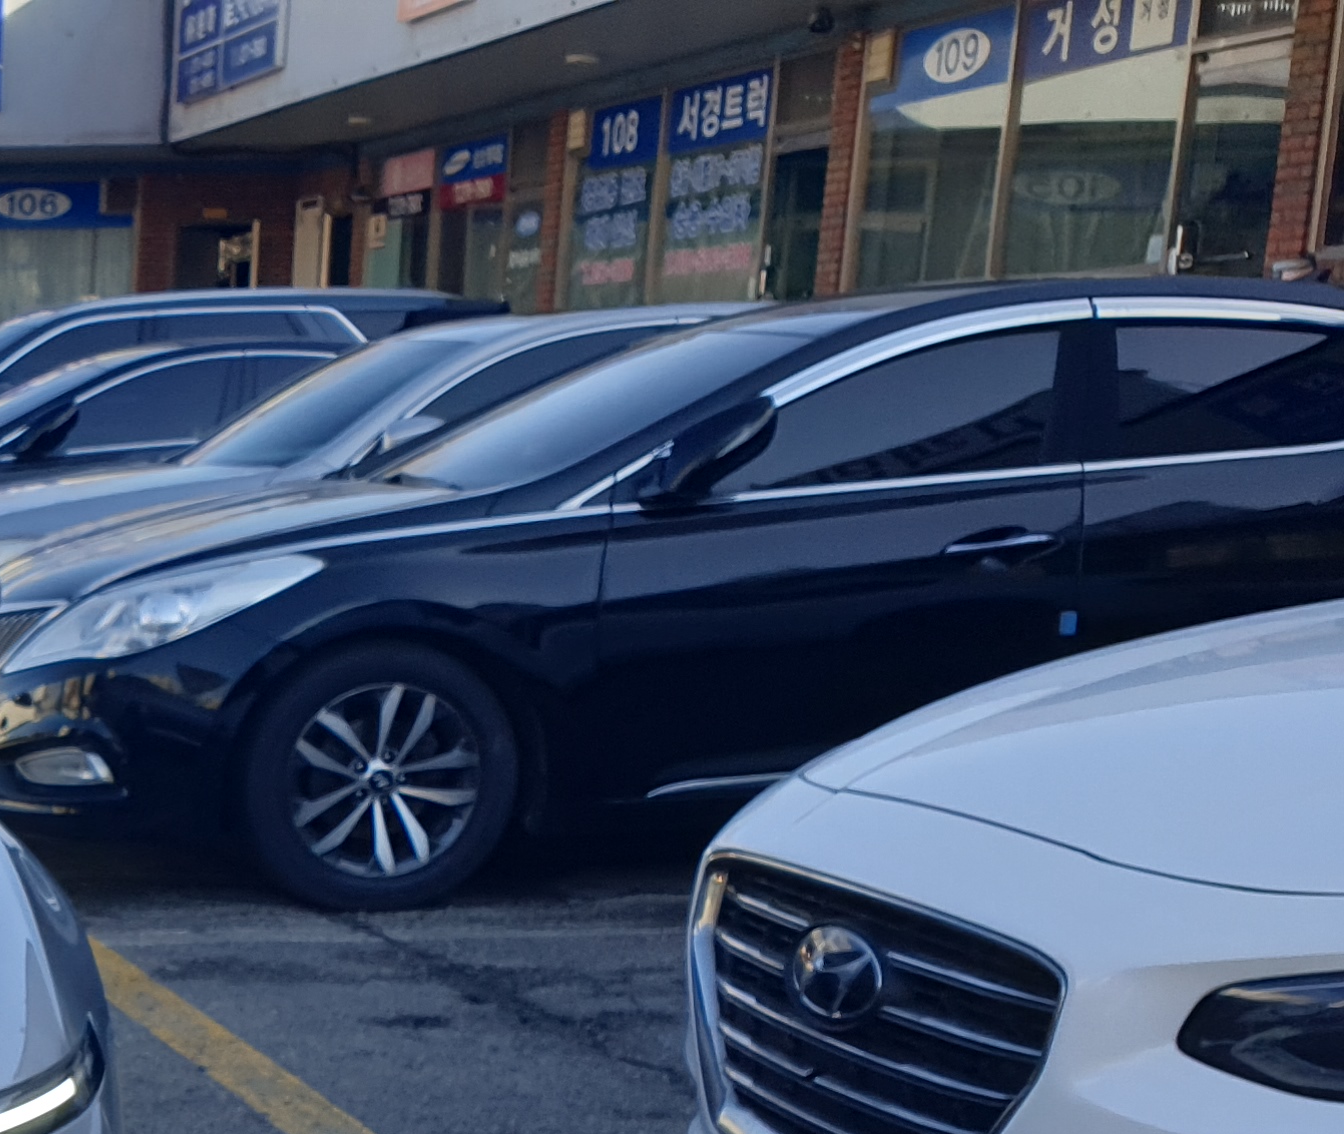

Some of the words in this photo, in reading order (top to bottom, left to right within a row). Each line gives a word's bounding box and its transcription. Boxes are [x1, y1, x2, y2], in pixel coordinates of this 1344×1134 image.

[936, 33, 979, 77] 109
[676, 74, 769, 141] 서경트럭
[601, 109, 640, 157] 108
[5, 193, 59, 216] 106
